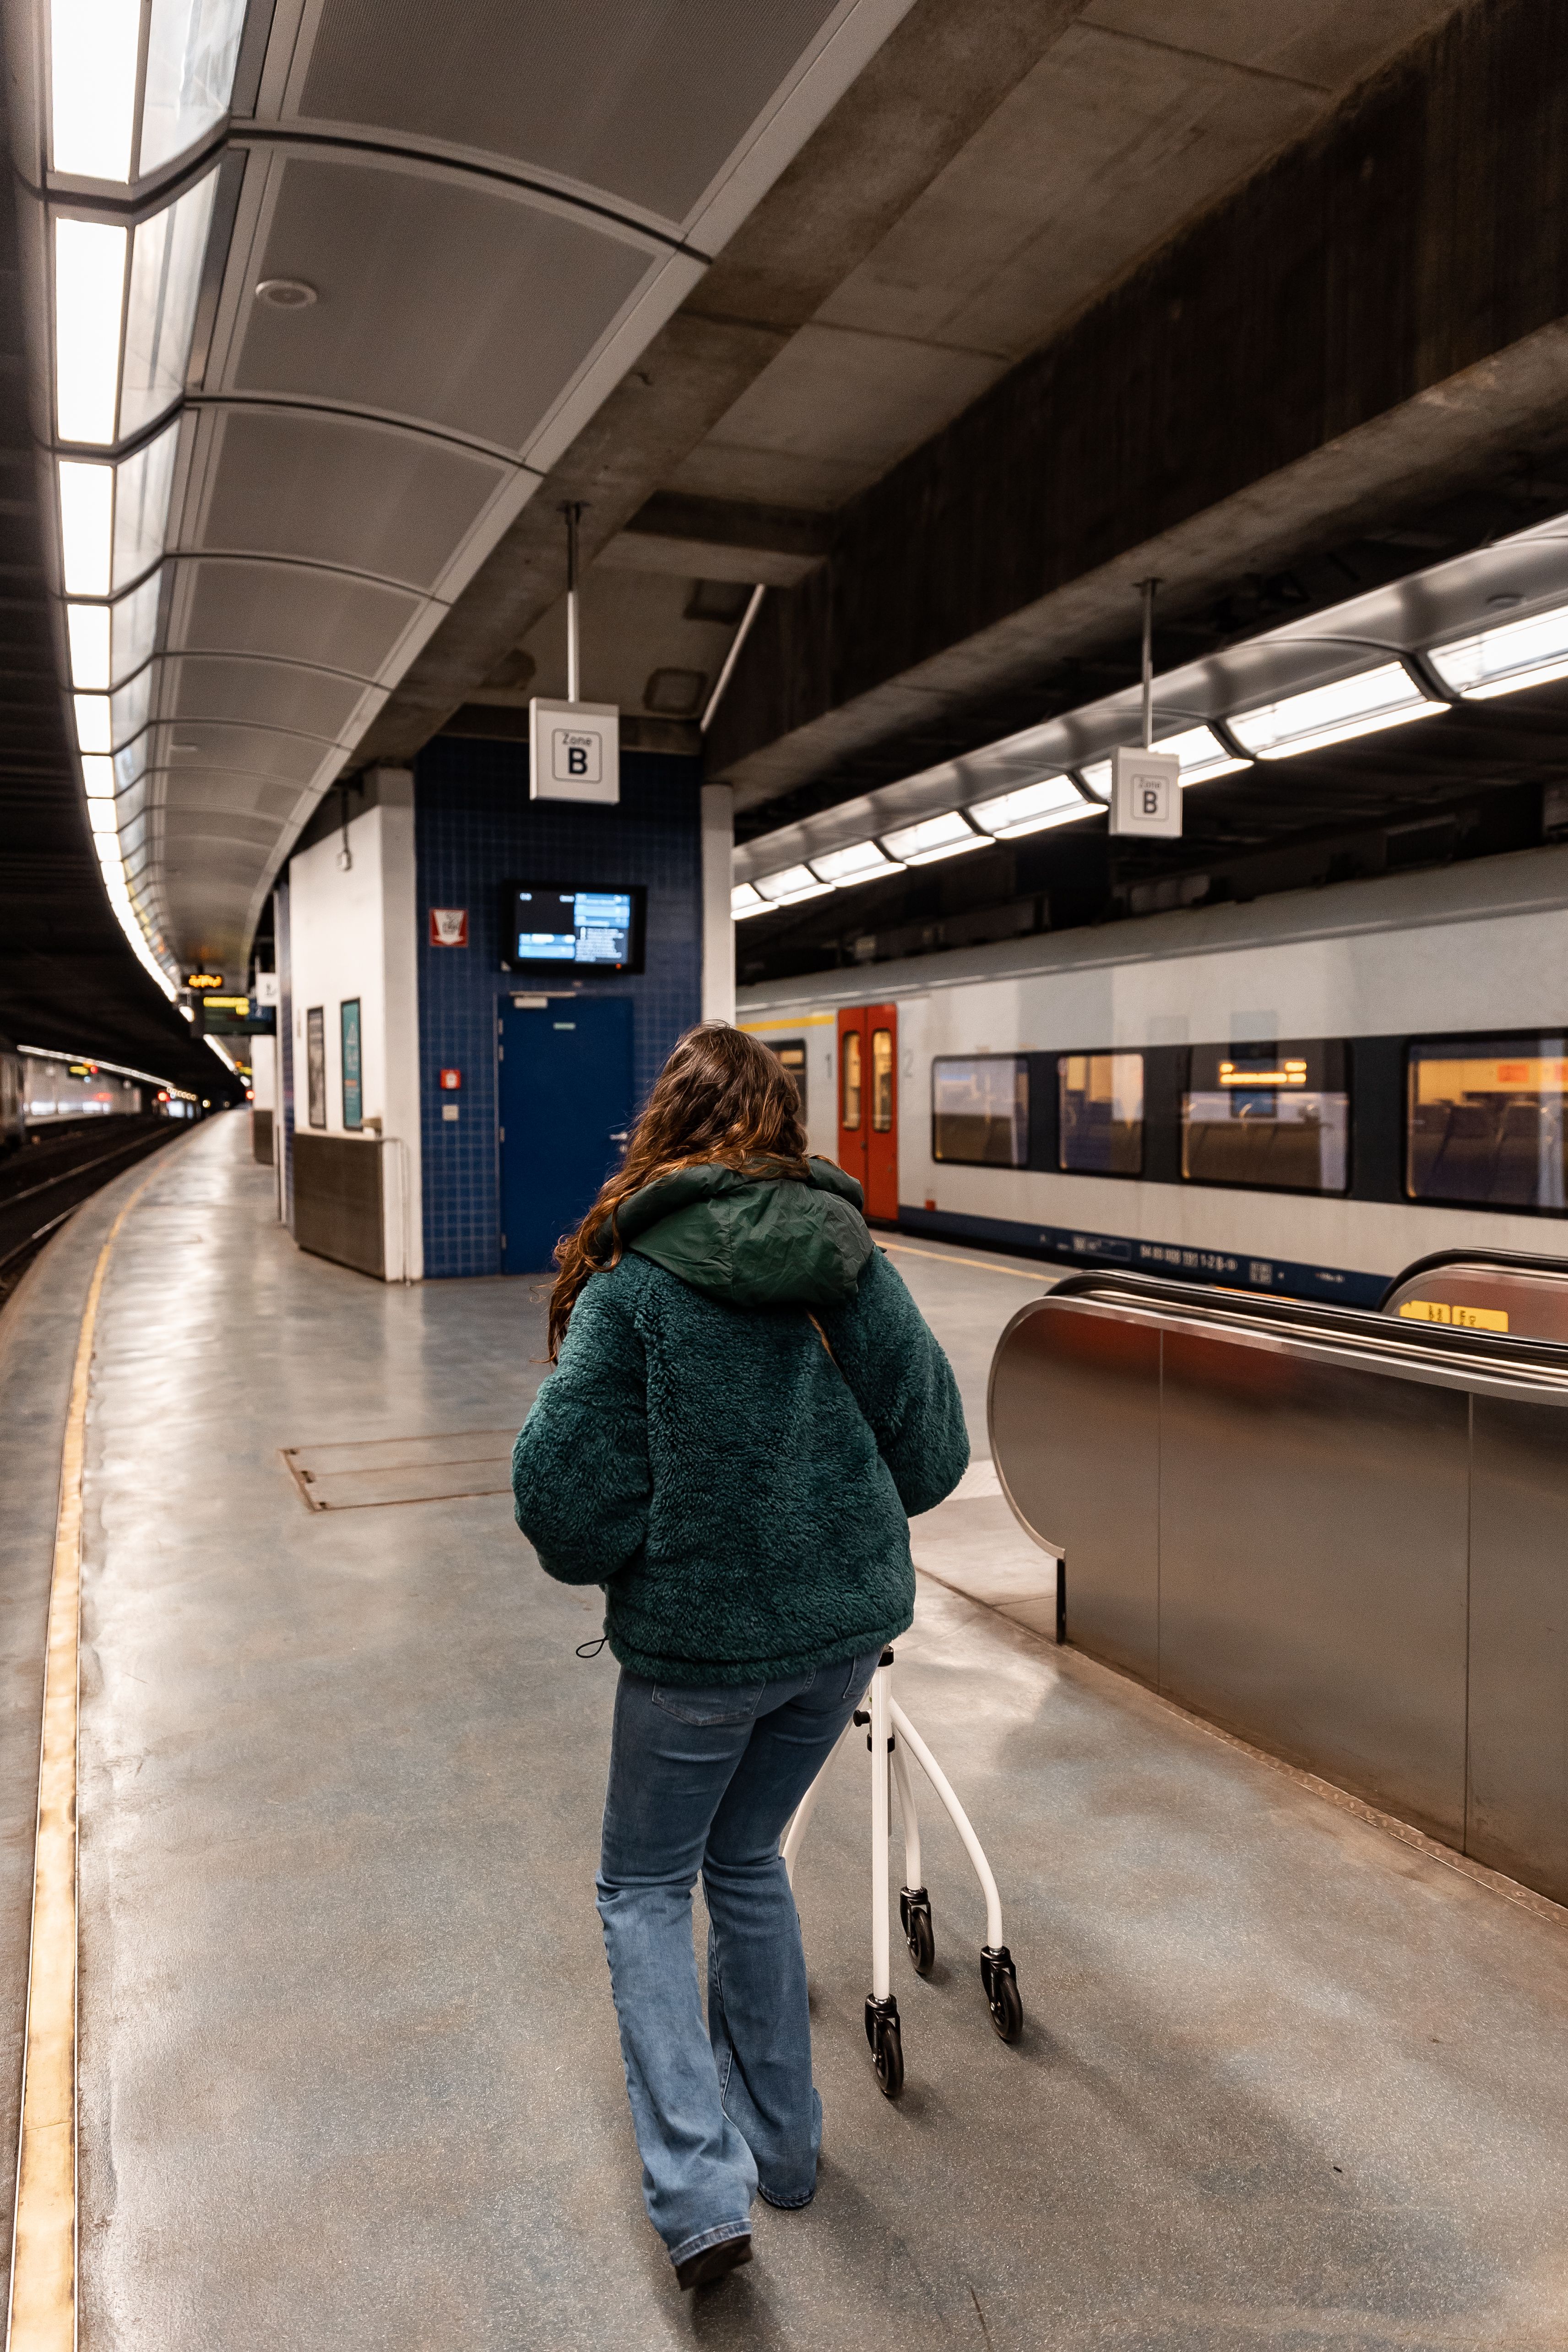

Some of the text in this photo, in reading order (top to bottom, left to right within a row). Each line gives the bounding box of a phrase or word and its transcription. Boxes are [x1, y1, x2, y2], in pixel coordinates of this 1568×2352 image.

[562, 733, 592, 747] Zone
[569, 747, 587, 775] B
[1138, 778, 1161, 789] Zone
[1144, 791, 1157, 814] B
